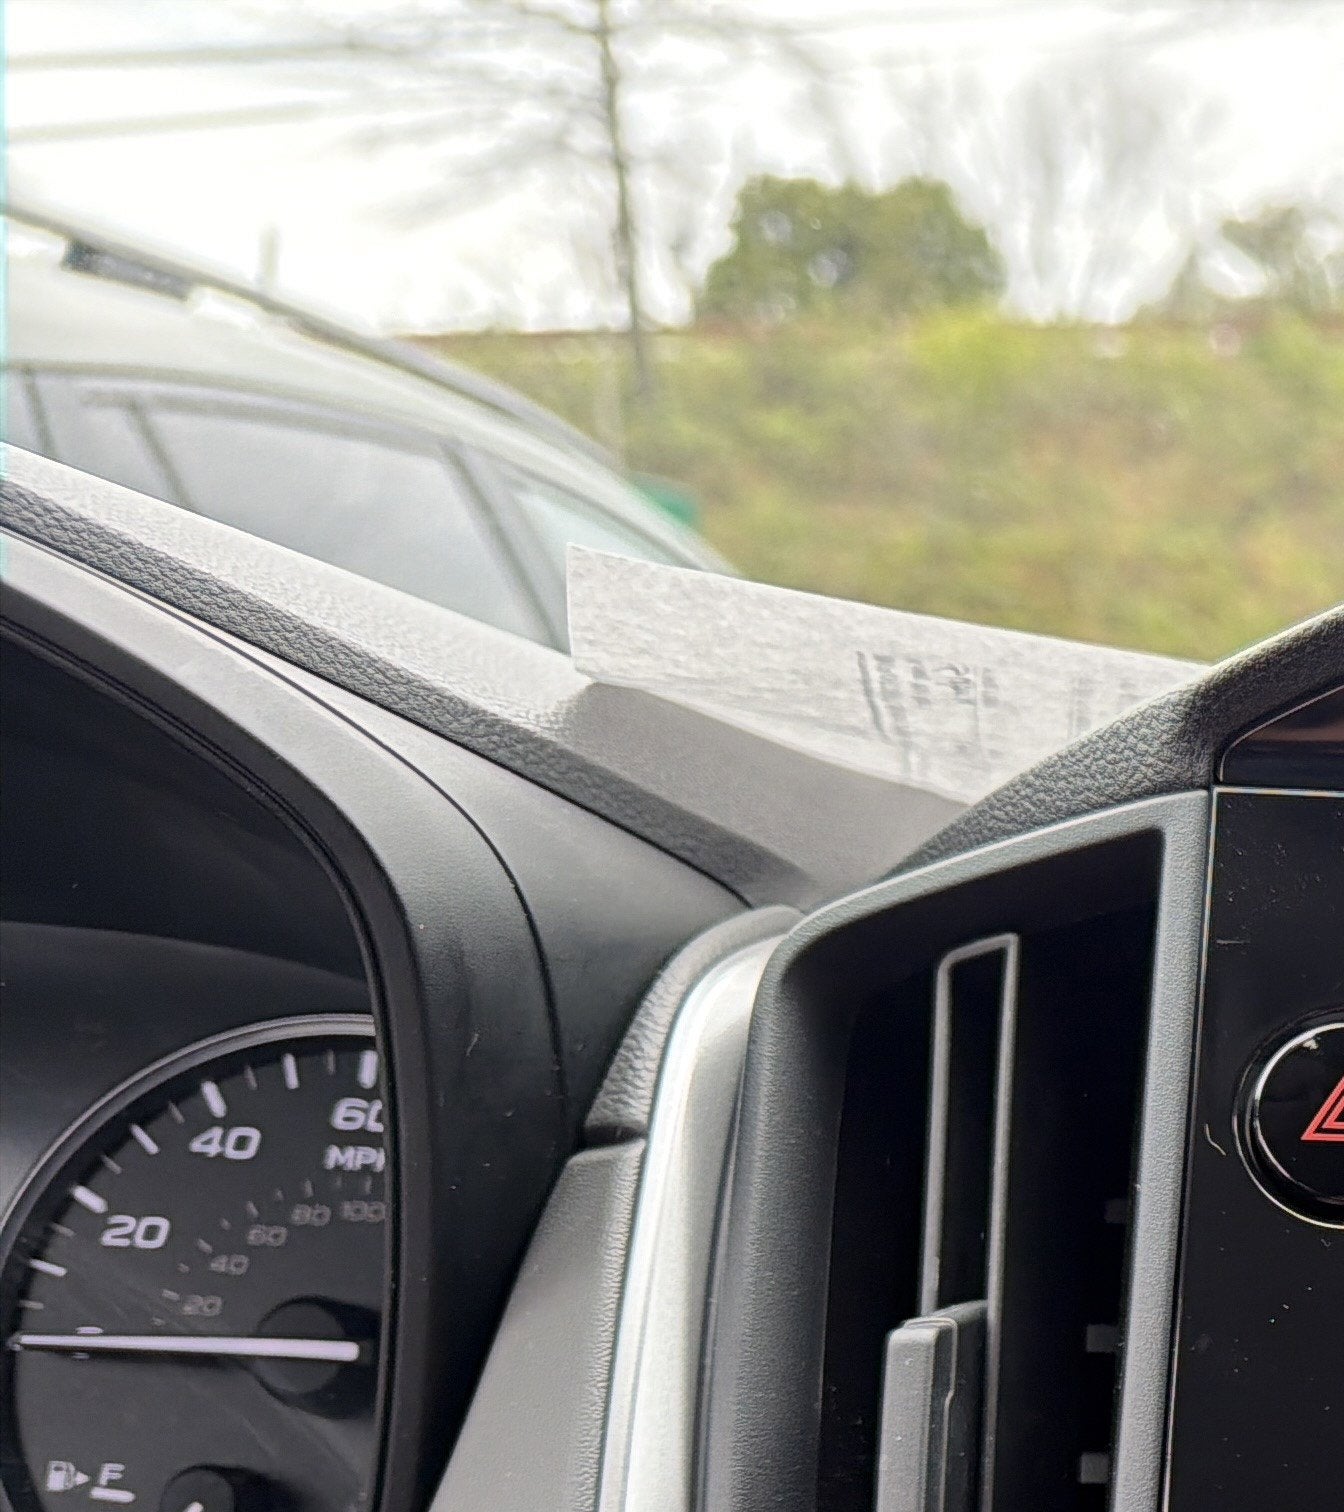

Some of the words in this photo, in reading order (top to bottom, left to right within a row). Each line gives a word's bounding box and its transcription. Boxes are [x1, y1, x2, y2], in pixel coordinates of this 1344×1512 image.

[190, 1126, 262, 1160] 40
[101, 1214, 170, 1249] 20
[99, 1462, 126, 1486] F
